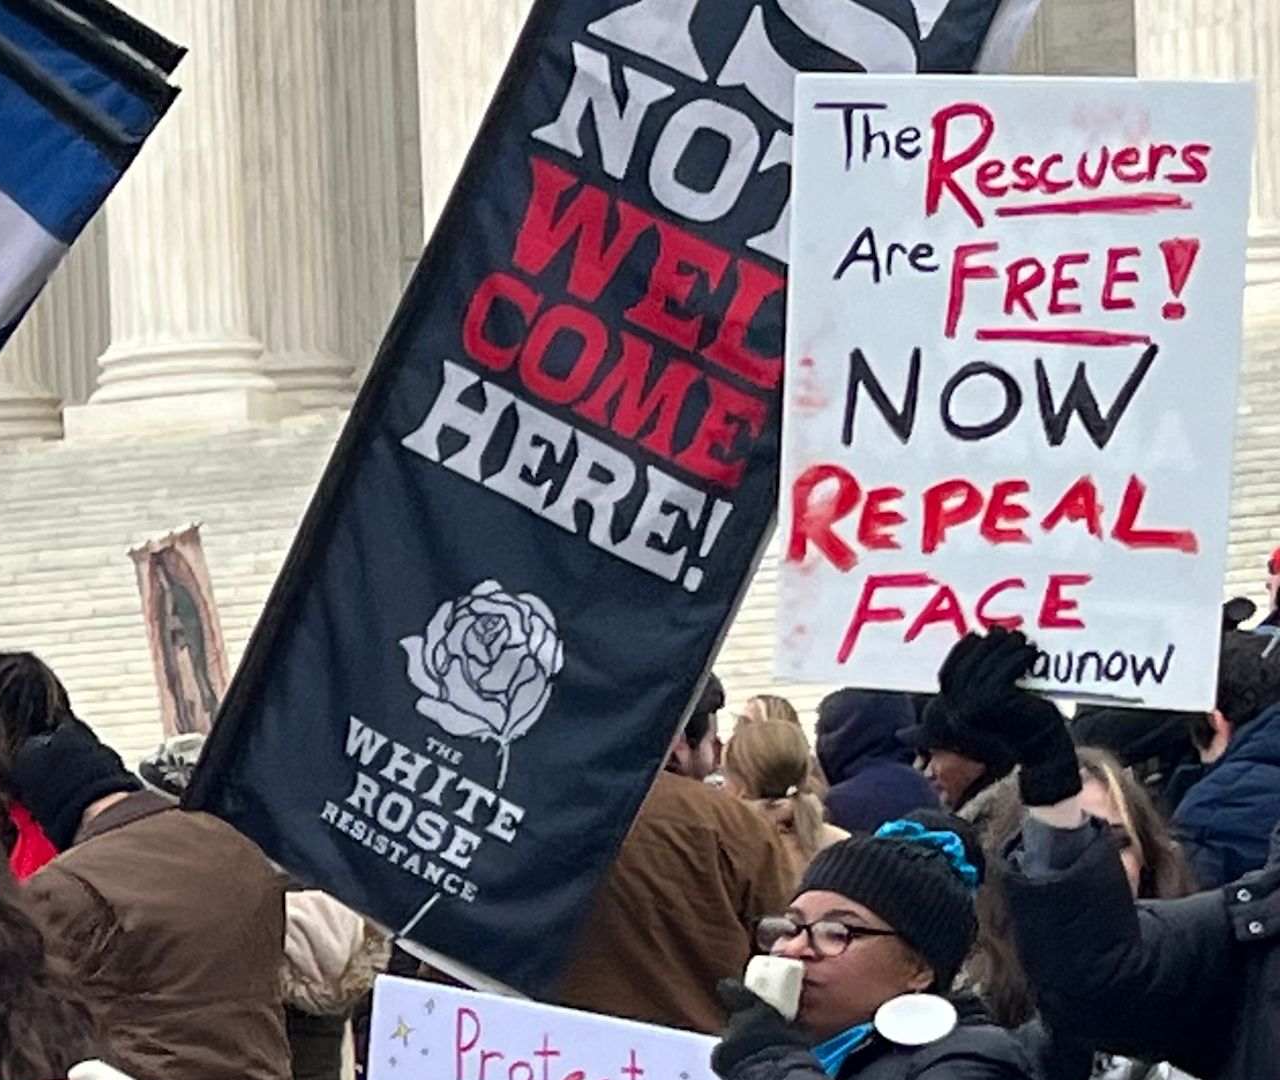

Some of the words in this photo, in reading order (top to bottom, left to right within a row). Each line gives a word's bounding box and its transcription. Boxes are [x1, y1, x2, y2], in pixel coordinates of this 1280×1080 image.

[814, 103, 921, 170] The
[925, 103, 1210, 227] Rescuers
[512, 156, 788, 389] WEL
[833, 227, 938, 283] Are
[945, 237, 1200, 339] FREE!
[463, 272, 766, 486] COME
[841, 344, 1159, 449] NOW
[401, 360, 733, 591] HERE!
[787, 464, 1199, 572] REPEAL
[837, 573, 1092, 664] FACE
[1030, 644, 1175, 687] aunow
[345, 715, 525, 843] WHITE
[426, 736, 464, 764] THE
[320, 801, 478, 903] RESISTANCE
[346, 772, 482, 869] ROSE
